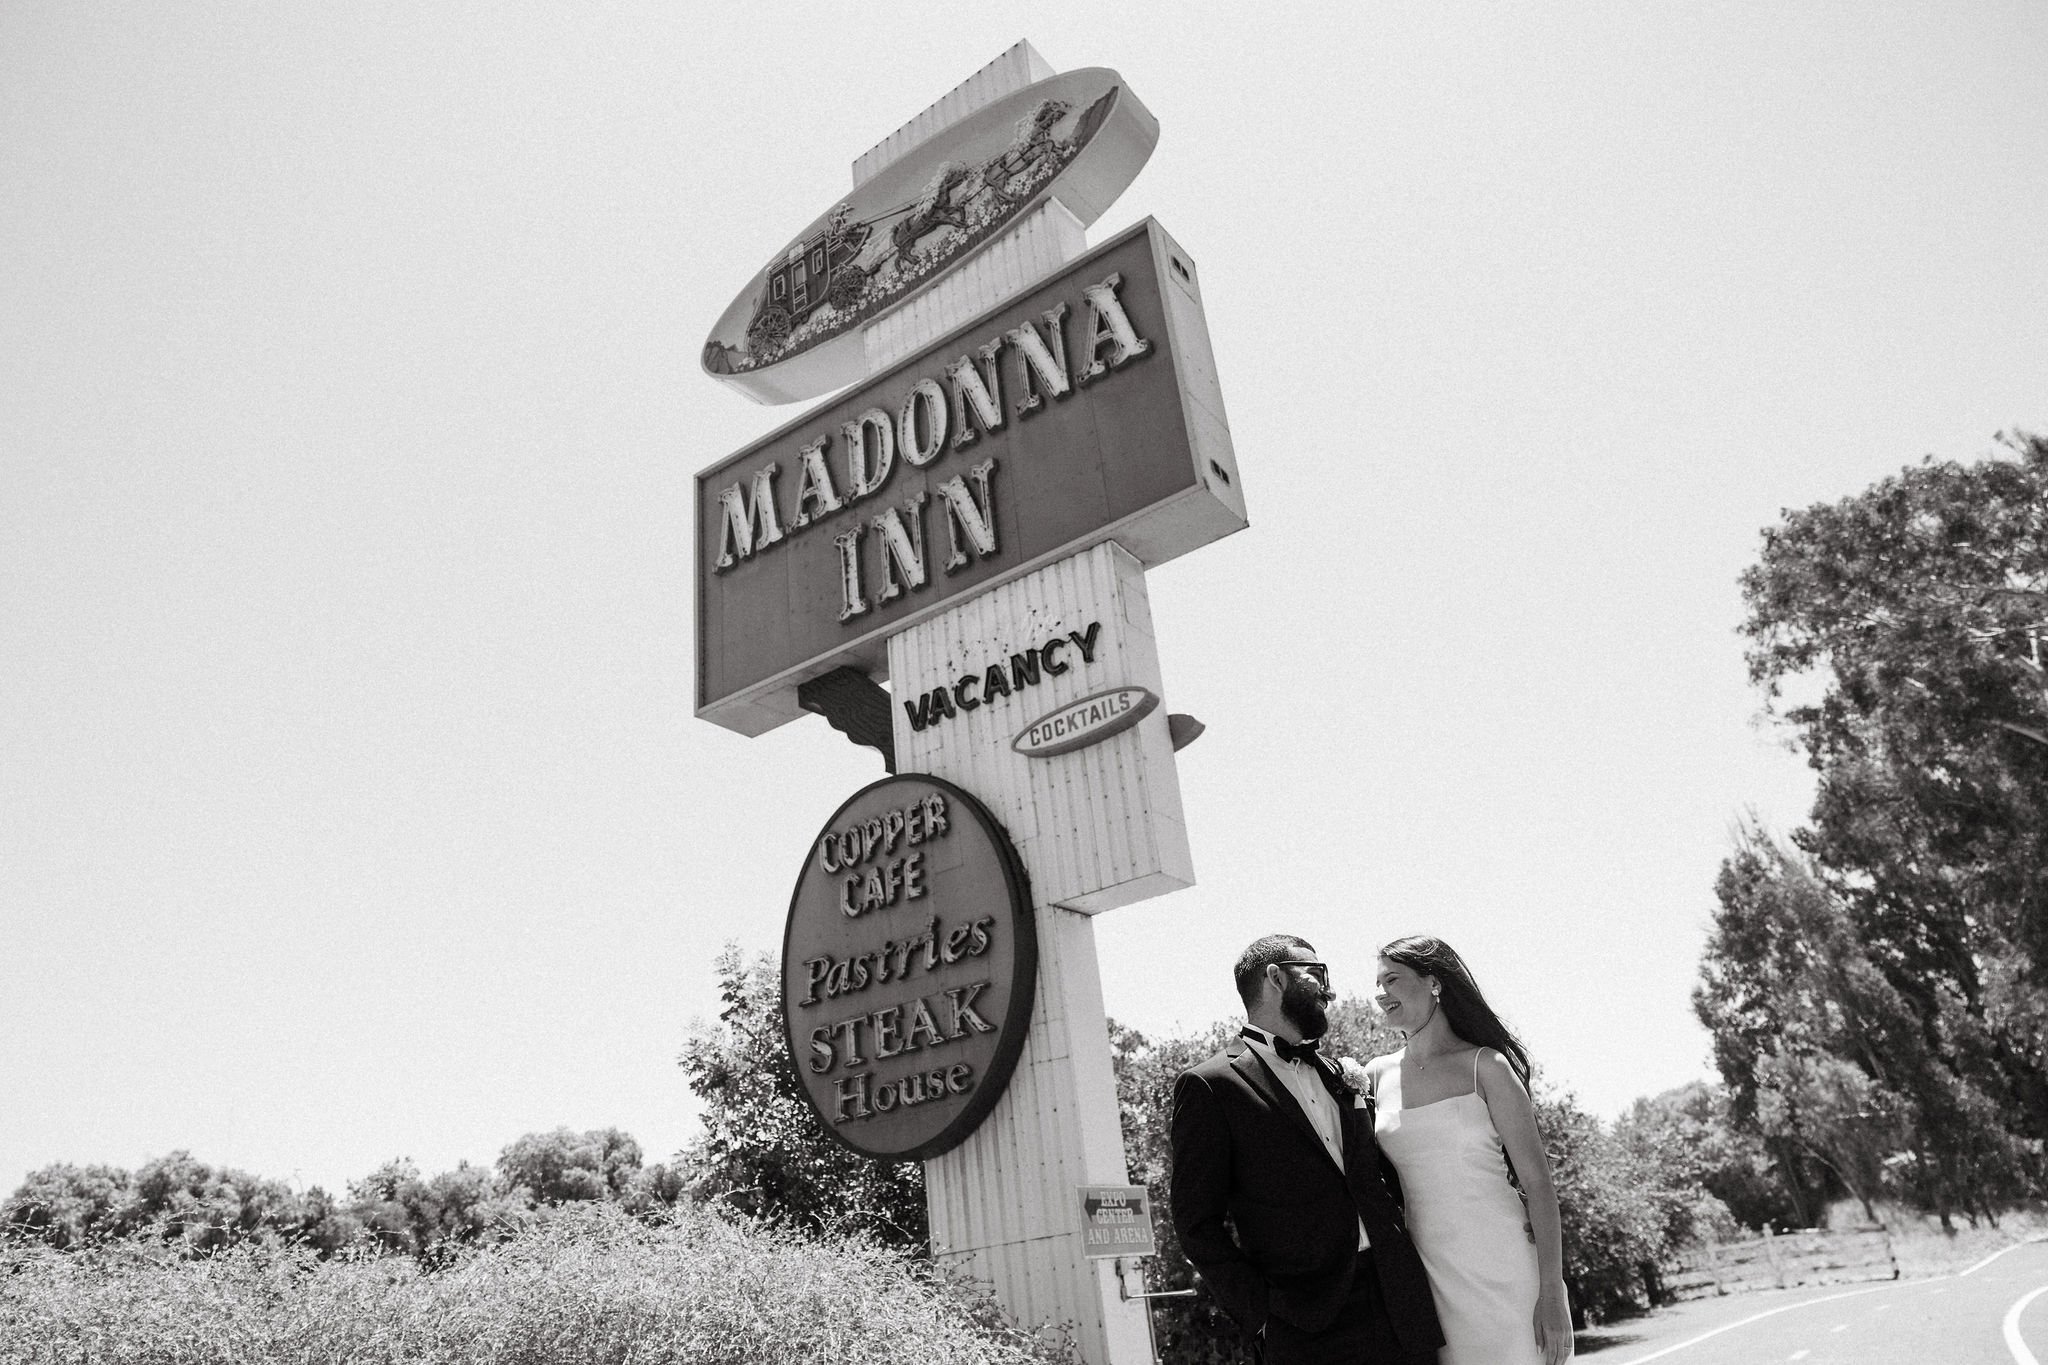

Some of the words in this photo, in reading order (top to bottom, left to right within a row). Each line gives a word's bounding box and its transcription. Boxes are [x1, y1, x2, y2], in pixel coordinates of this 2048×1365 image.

[712, 272, 1152, 575] MADONNA
[834, 456, 997, 625] INN
[904, 621, 1101, 732] VACANCY
[1030, 692, 1131, 747] COCKTAILS
[818, 792, 950, 874] COPPER
[840, 852, 925, 918] CAFE
[799, 914, 995, 1008] Pastries
[808, 981, 997, 1074] STEAK
[832, 1061, 974, 1125] House
[1087, 1228, 1110, 1245] AND
[1113, 1226, 1149, 1244] ARENA
[1096, 1208, 1135, 1225] CENTER
[1100, 1191, 1127, 1208] EXPO
